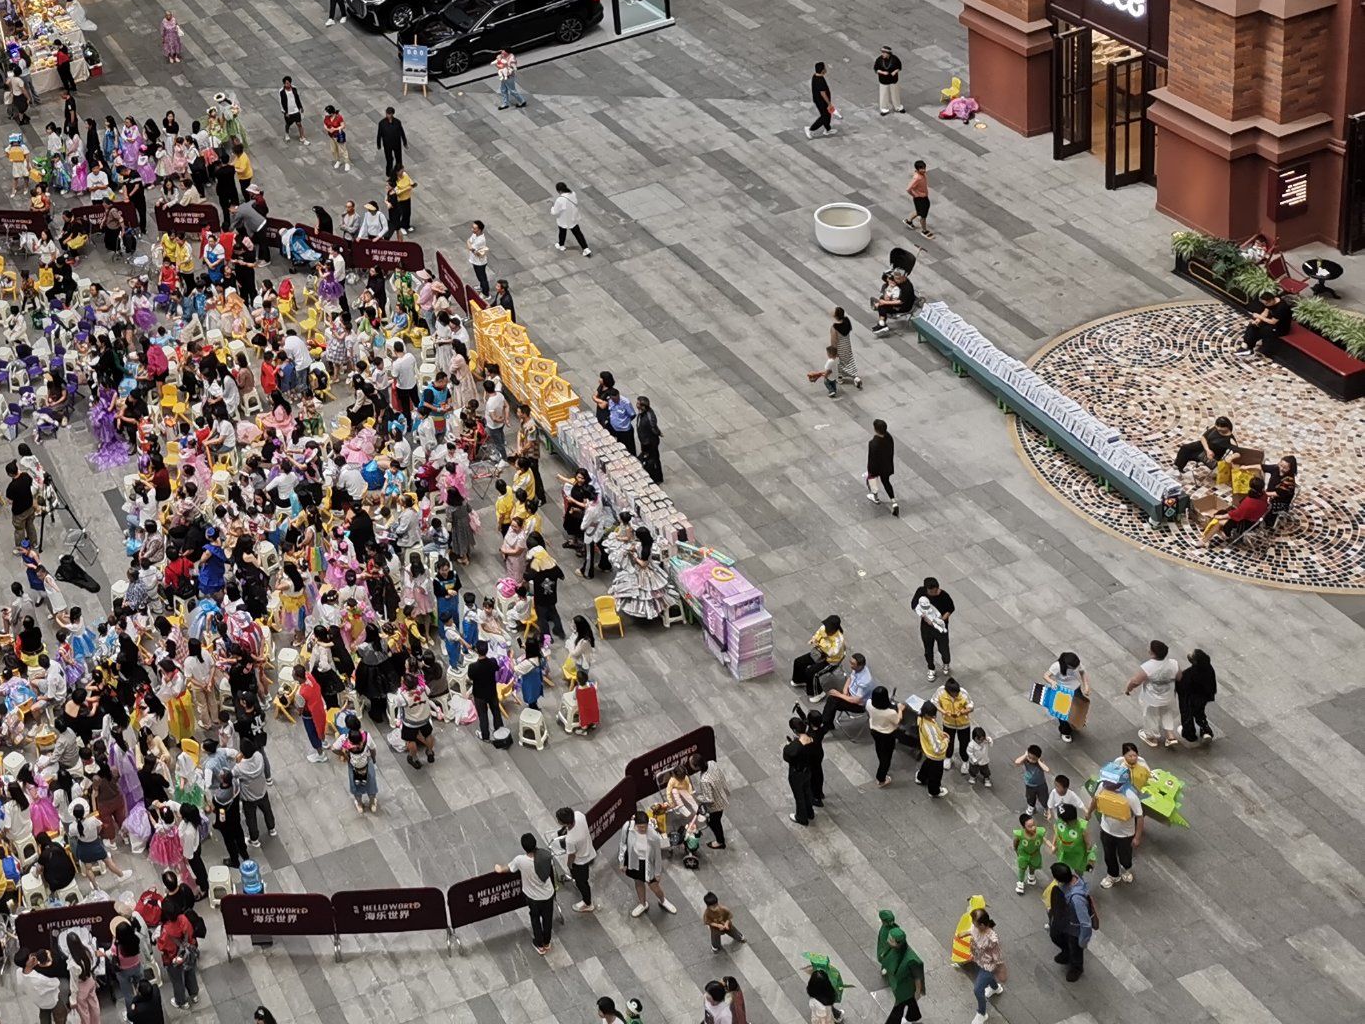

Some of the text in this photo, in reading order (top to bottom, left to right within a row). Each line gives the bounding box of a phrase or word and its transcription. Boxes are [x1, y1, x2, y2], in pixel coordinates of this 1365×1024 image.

[477, 879, 521, 898] HELLOWOR
[253, 914, 298, 924] 海乐世界
[365, 910, 410, 921] 海乐世界
